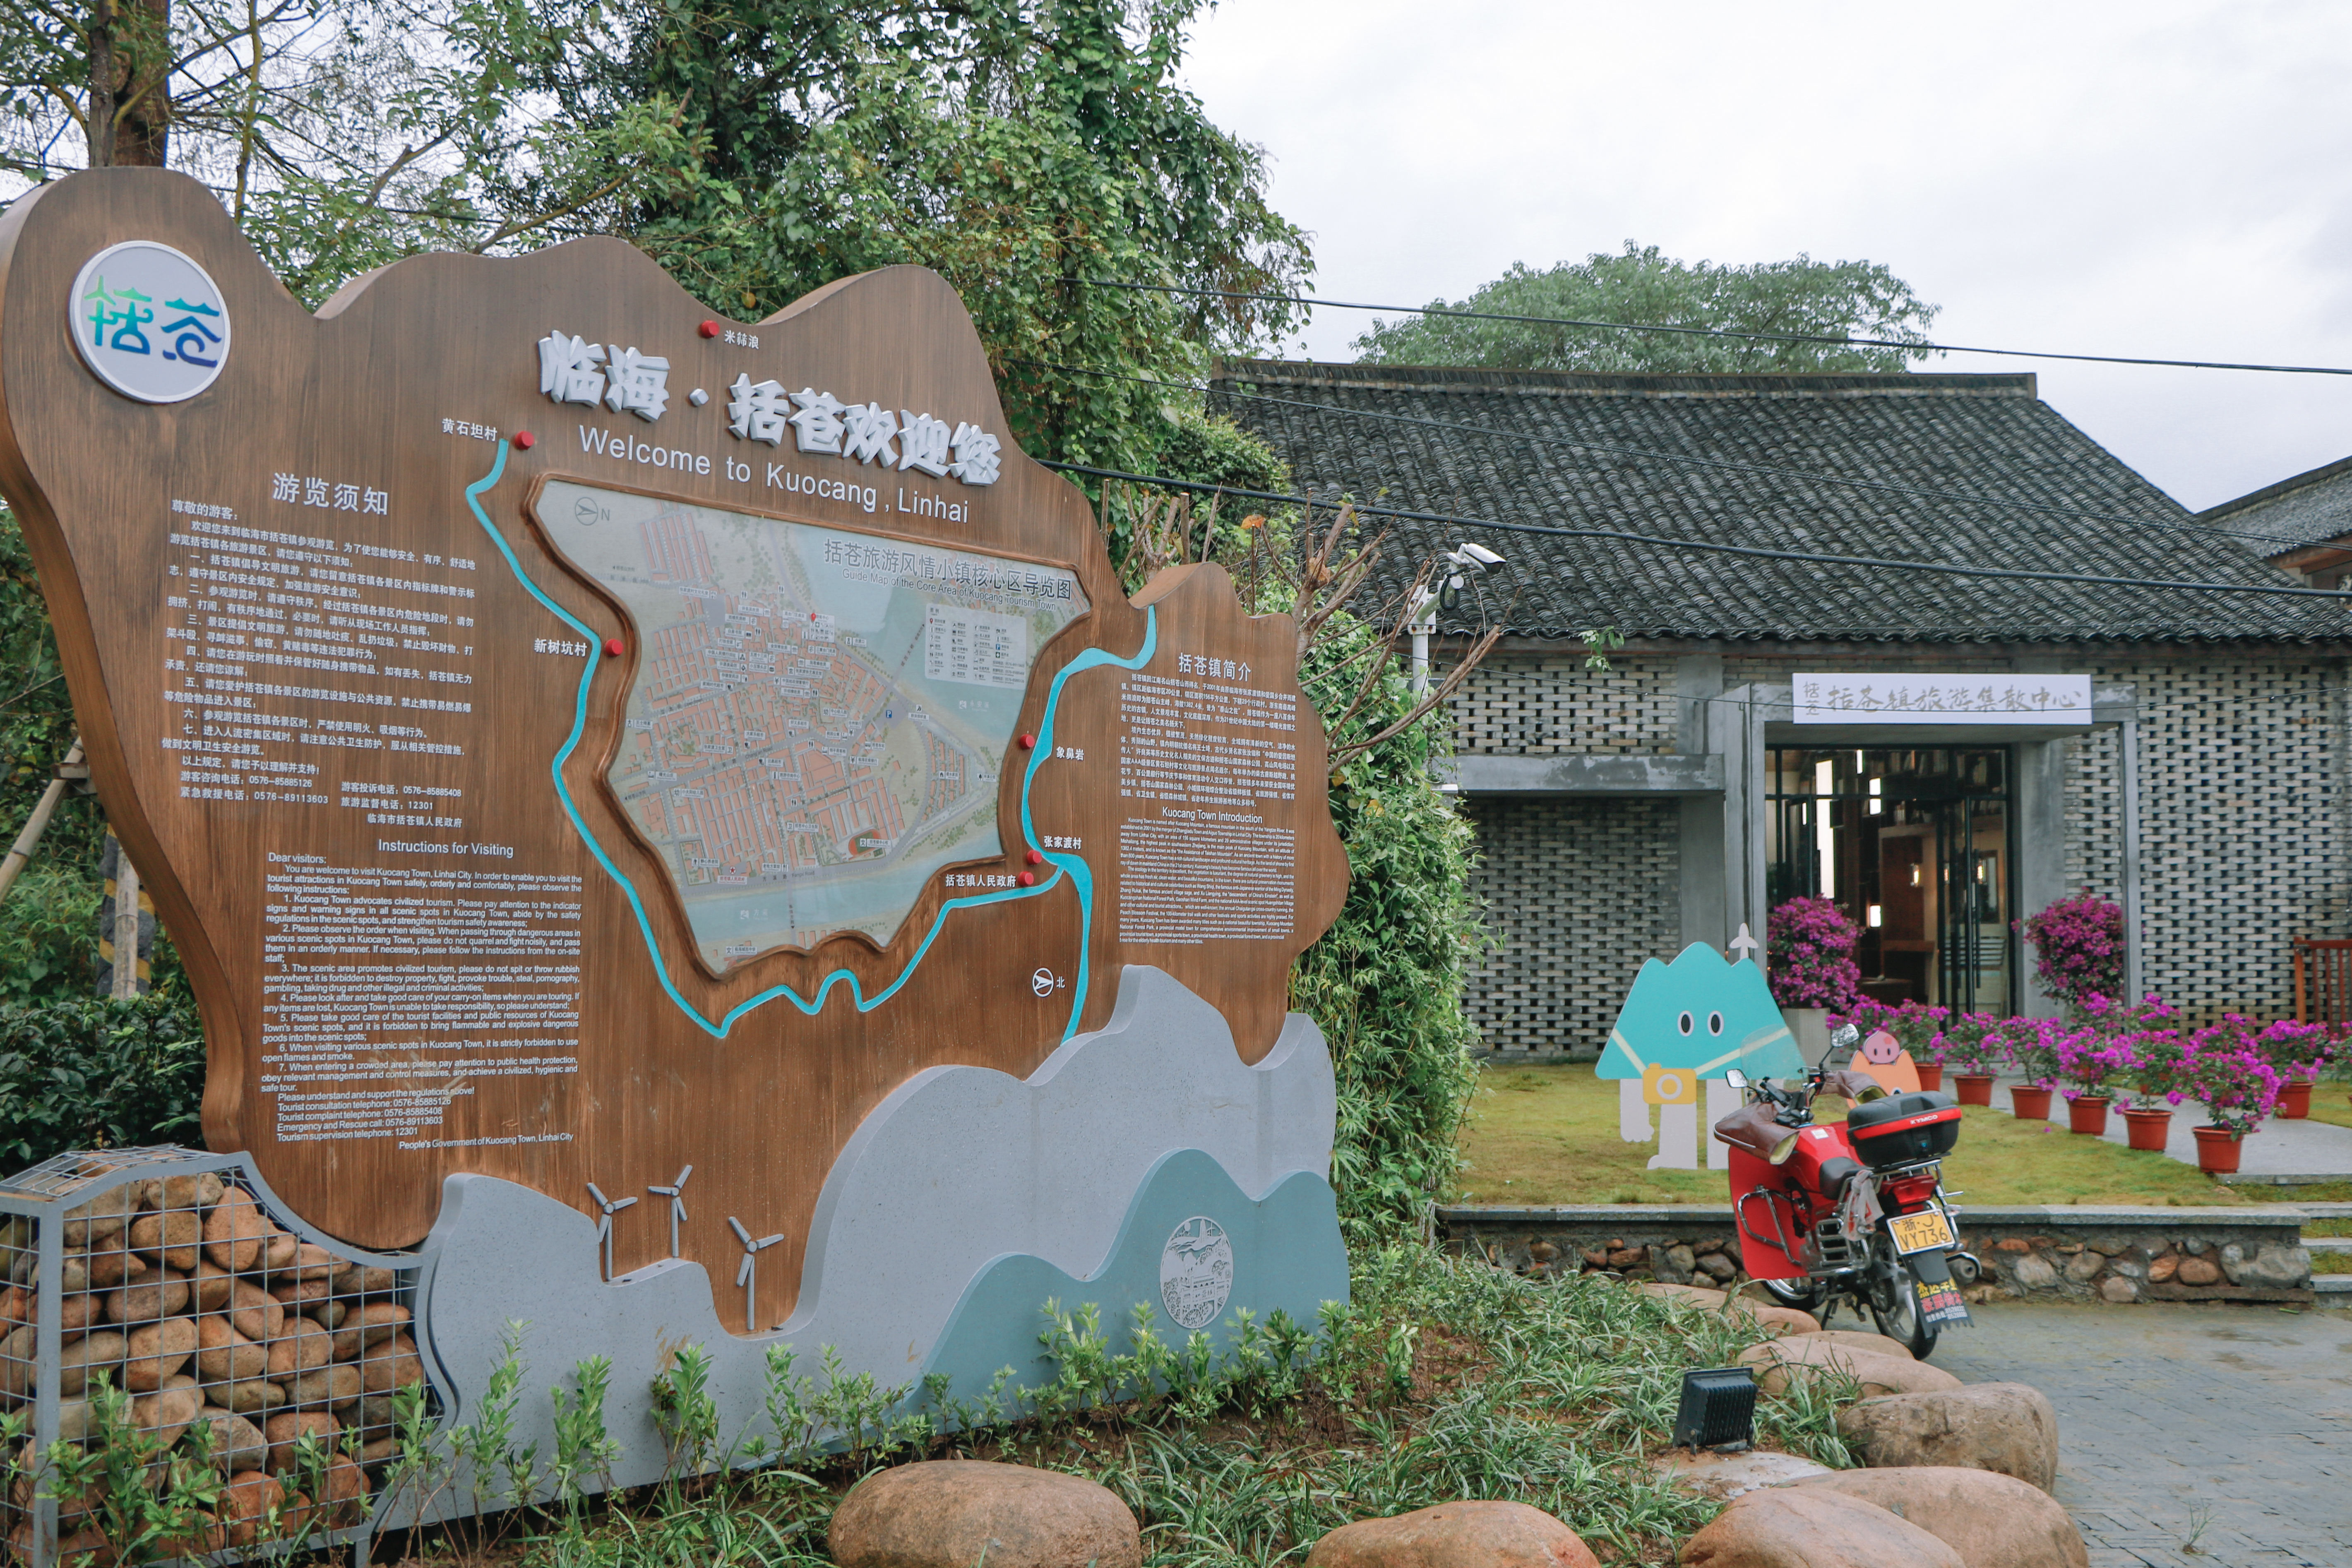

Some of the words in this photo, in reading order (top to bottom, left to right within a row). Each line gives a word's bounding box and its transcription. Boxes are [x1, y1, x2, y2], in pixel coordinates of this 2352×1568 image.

[724, 329, 759, 350] 米筛浪
[442, 418, 497, 442] 黄石坦村
[579, 424, 711, 475] Welcome
[726, 454, 752, 483] to
[899, 487, 968, 523] Linhai
[272, 471, 388, 516] 游览须知
[172, 499, 238, 520] 尊敬的游客：
[601, 510, 610, 521] N
[824, 537, 1071, 601] 括苍旅游风情小镇核心区导览图
[842, 567, 869, 582] Guide
[870, 572, 888, 588] Map
[891, 575, 899, 587] of
[901, 576, 913, 589] the
[917, 579, 936, 593] Core
[938, 582, 957, 596] Area
[959, 586, 967, 598] of
[969, 587, 1002, 605] Kuocang
[1005, 593, 1035, 608] Tourism
[1036, 597, 1056, 611] Town
[534, 638, 587, 657] 新树坑村
[1179, 652, 1251, 682] 括苍镇简介
[1828, 684, 2081, 713] 括苍镇旅游集散中心
[1056, 746, 1084, 761] 象鼻岩
[368, 813, 462, 828] 临海市括苍镇人民政府
[1163, 806, 1195, 820] Kuocang
[1197, 809, 1216, 821] Town
[1219, 811, 1263, 824] Introduction
[378, 838, 449, 853] Instructions
[452, 842, 468, 854] for
[471, 843, 514, 859] Visiting
[1044, 835, 1082, 850] 张家渡村
[268, 852, 291, 862] Dear
[292, 853, 327, 864] visitors:
[285, 864, 300, 873] You
[315, 865, 350, 875] welcome
[351, 867, 359, 875] to
[360, 867, 375, 876] visit
[376, 867, 410, 878] Kuocang
[434, 869, 456, 878] Linhai
[483, 872, 502, 880] order
[502, 872, 510, 880] to
[511, 872, 534, 881] enable
[945, 874, 1016, 887] 括苍镇人民政府
[267, 874, 292, 883] tourist
[294, 875, 335, 884] attractions
[346, 876, 380, 887] Kuocang
[382, 878, 402, 886] Town
[430, 879, 455, 889] orderly
[517, 882, 541, 892] please
[267, 884, 302, 895] following
[303, 885, 349, 894] instructions:
[264, 954, 284, 963] staff;
[1057, 977, 1065, 988] 北
[277, 1102, 304, 1112] Tourist
[305, 1100, 352, 1110] consultation
[353, 1099, 392, 1110] telephone:
[393, 1097, 451, 1107] 0576-85885126
[276, 1112, 304, 1121] Tourist
[305, 1111, 342, 1122] complaint
[343, 1109, 383, 1120] telephone:
[384, 1107, 442, 1117] 0576-85885408
[1910, 1114, 1938, 1125] KYMCO
[276, 1121, 322, 1133] Emergency
[323, 1121, 338, 1129] and
[339, 1119, 368, 1129] Rescue
[369, 1119, 384, 1127] call:
[385, 1116, 443, 1126] 0576-89113603
[276, 1132, 308, 1141] Tourism
[309, 1130, 353, 1141] supervision
[354, 1128, 394, 1139] telephone:
[395, 1126, 417, 1136] 12301
[1900, 1227, 1948, 1249] VY736
